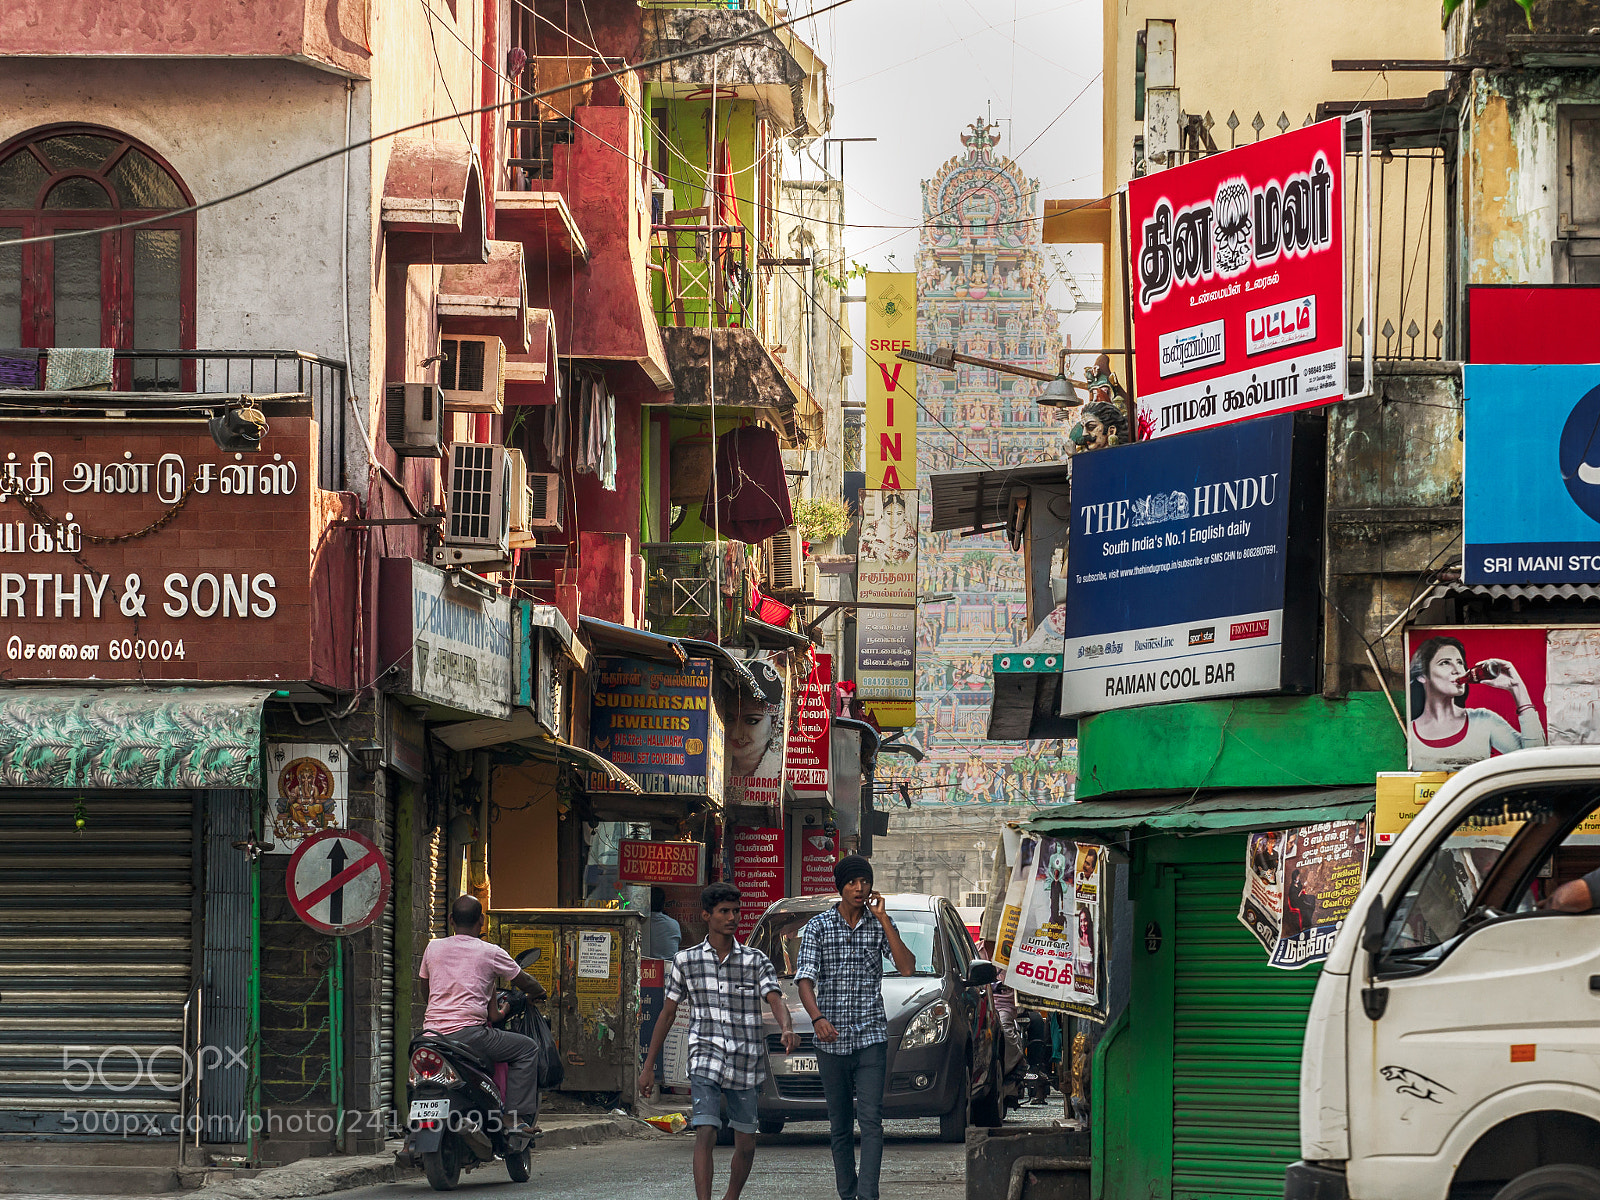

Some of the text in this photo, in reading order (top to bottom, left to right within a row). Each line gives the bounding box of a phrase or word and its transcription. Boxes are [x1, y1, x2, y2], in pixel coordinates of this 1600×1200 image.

[1189, 271, 1280, 306] உண்மையின் உரைகல்
[869, 339, 911, 352] SREE
[1160, 362, 1300, 432] ராமன் கூல்பார்
[63, 450, 186, 504] அண்டு
[193, 452, 298, 495] சன்ஸ்
[1081, 473, 1279, 536] THE HINDU
[1102, 541, 1130, 557] South
[1132, 534, 1163, 552] India's
[1189, 524, 1224, 544] English
[1227, 520, 1252, 537] daily
[1076, 575, 1082, 584] To
[1082, 571, 1107, 582] subscribe,
[1108, 569, 1120, 580] visit
[1120, 556, 1204, 578] www.thehindugroup.in/subscribe
[1204, 557, 1210, 565] or
[1210, 553, 1223, 565] SMS
[1224, 551, 1236, 561] CHN
[1237, 550, 1243, 560] to
[1484, 557, 1513, 573] SRI
[1517, 556, 1563, 572] MANI
[859, 568, 916, 586] சகுந்தலா
[0, 572, 277, 618] RTHY & SONS
[1231, 620, 1269, 636] FRONTLINE
[489, 617, 511, 660] SONS
[1134, 636, 1175, 651] BusinessLine
[109, 638, 186, 661] 600004
[1105, 662, 1236, 697] RAMAN COOL BAR
[594, 692, 708, 710] SUDHARSAN
[610, 714, 690, 731] JEWELLERS
[647, 735, 684, 748] HALLMARK
[612, 752, 685, 766] BRIDAL SET COVERING
[668, 774, 706, 793] WORKS
[729, 776, 778, 789] SRI SWARNA
[1303, 836, 1310, 847] 8
[622, 844, 696, 861] SUDHARSAN
[623, 860, 695, 877] JEWELLERS
[1331, 866, 1361, 881] ரஜினி
[1028, 937, 1070, 950] பாபாவா?
[1015, 959, 1073, 985] கல்கி
[794, 1059, 806, 1071] TN
